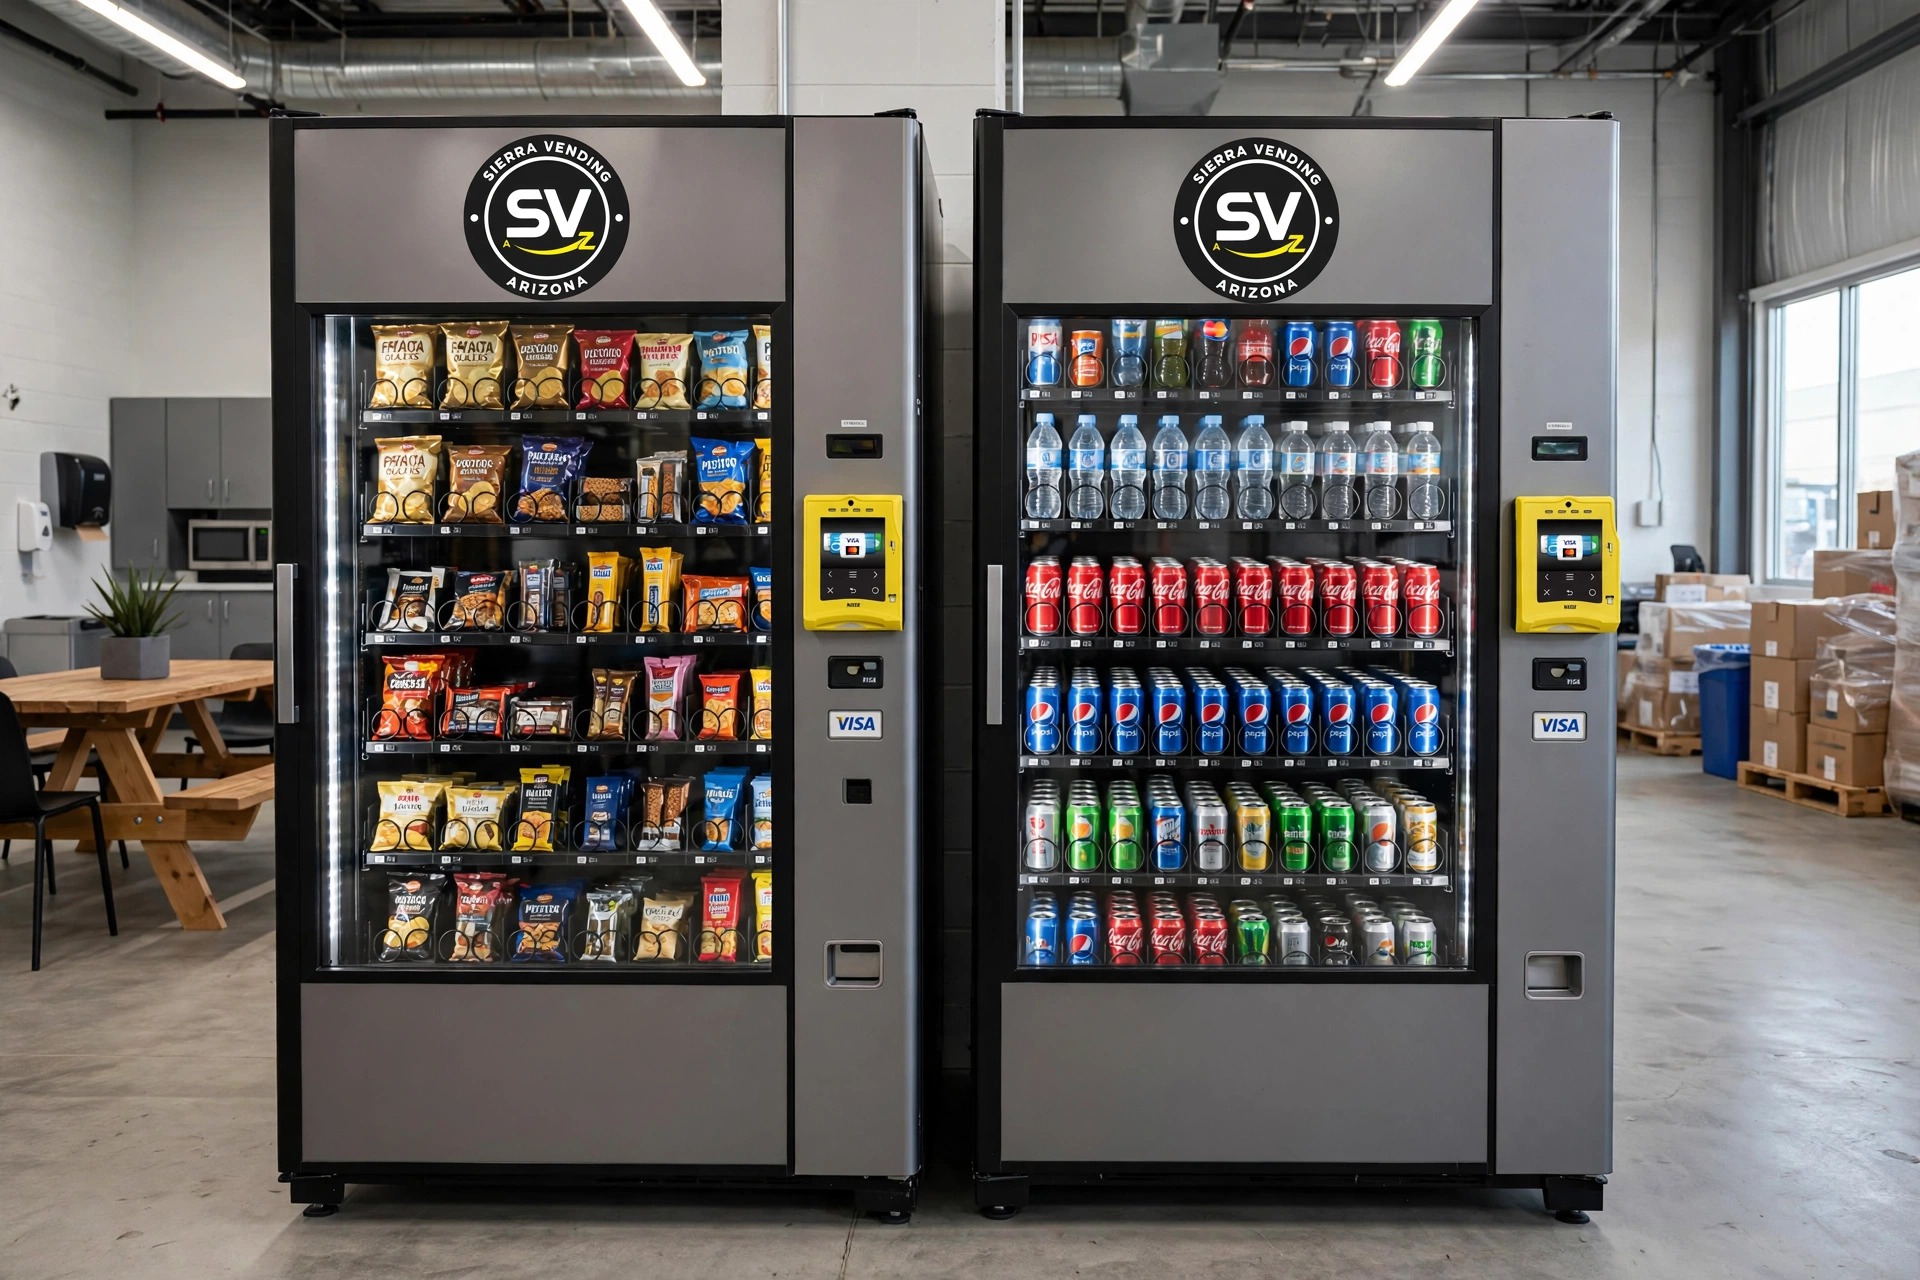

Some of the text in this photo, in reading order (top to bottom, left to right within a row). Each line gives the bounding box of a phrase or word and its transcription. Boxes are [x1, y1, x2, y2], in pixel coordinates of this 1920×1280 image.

[483, 140, 612, 183] SIERRA VENDING
[1193, 143, 1322, 186] SIERRA VENDING
[506, 188, 592, 238] SV
[1216, 192, 1302, 241] SV
[506, 276, 588, 296] ARIZONA
[1215, 279, 1298, 299] ARIZONA
[836, 717, 876, 730] VISA
[1540, 719, 1579, 732] VISA
